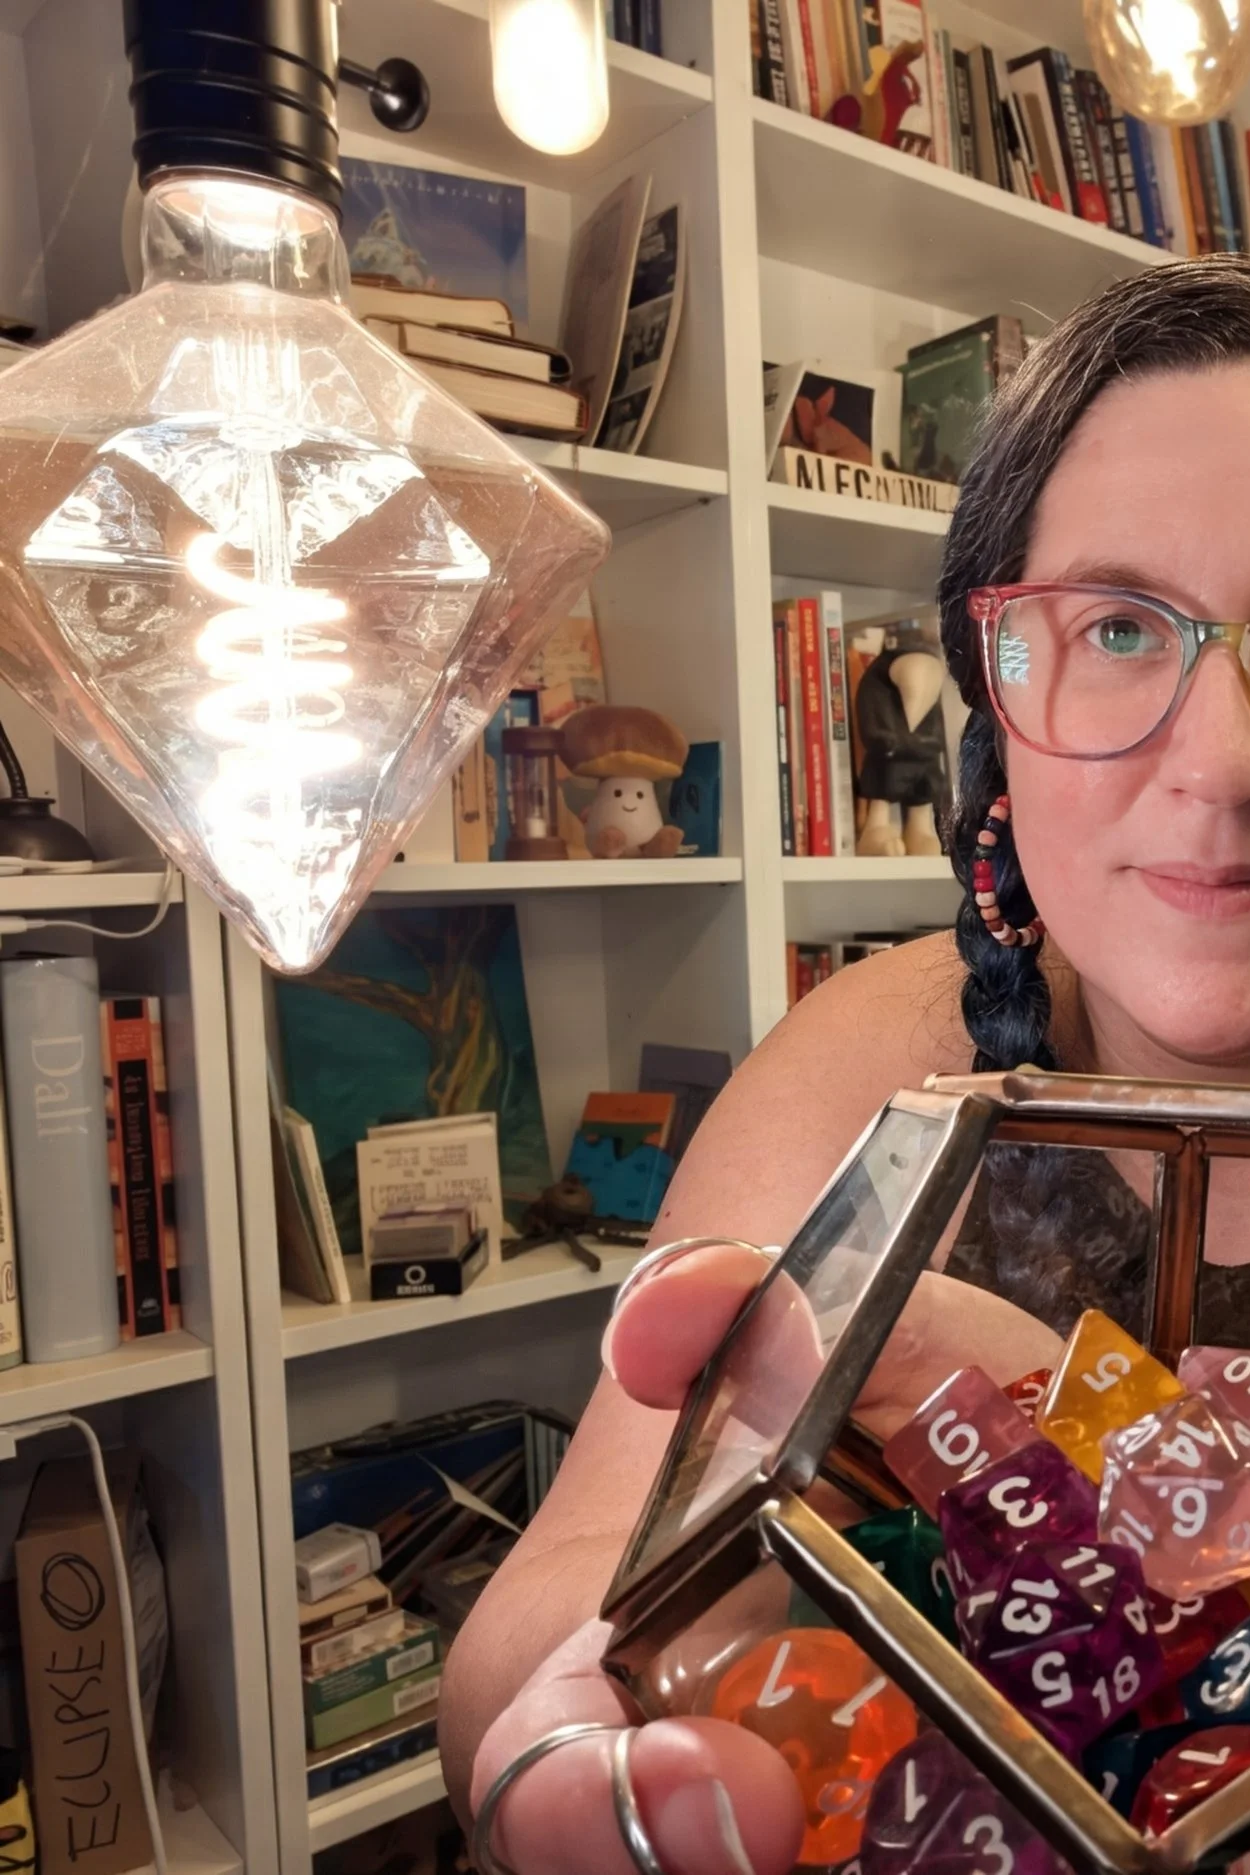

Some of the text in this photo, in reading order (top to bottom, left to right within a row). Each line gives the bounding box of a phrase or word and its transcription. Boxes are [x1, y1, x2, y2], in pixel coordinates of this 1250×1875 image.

[30, 1033, 92, 1139] Dalí
[1082, 1352, 1131, 1393] 5
[1159, 1420, 1216, 1468] 14
[987, 1475, 1049, 1528] 3
[1060, 1546, 1116, 1589] 11
[1001, 1577, 1060, 1636] 13
[1123, 1593, 1149, 1637] 4
[1031, 1650, 1075, 1710] 5
[1091, 1654, 1141, 1720] 18
[904, 1759, 928, 1823] 1
[963, 1814, 1015, 1875] 3
